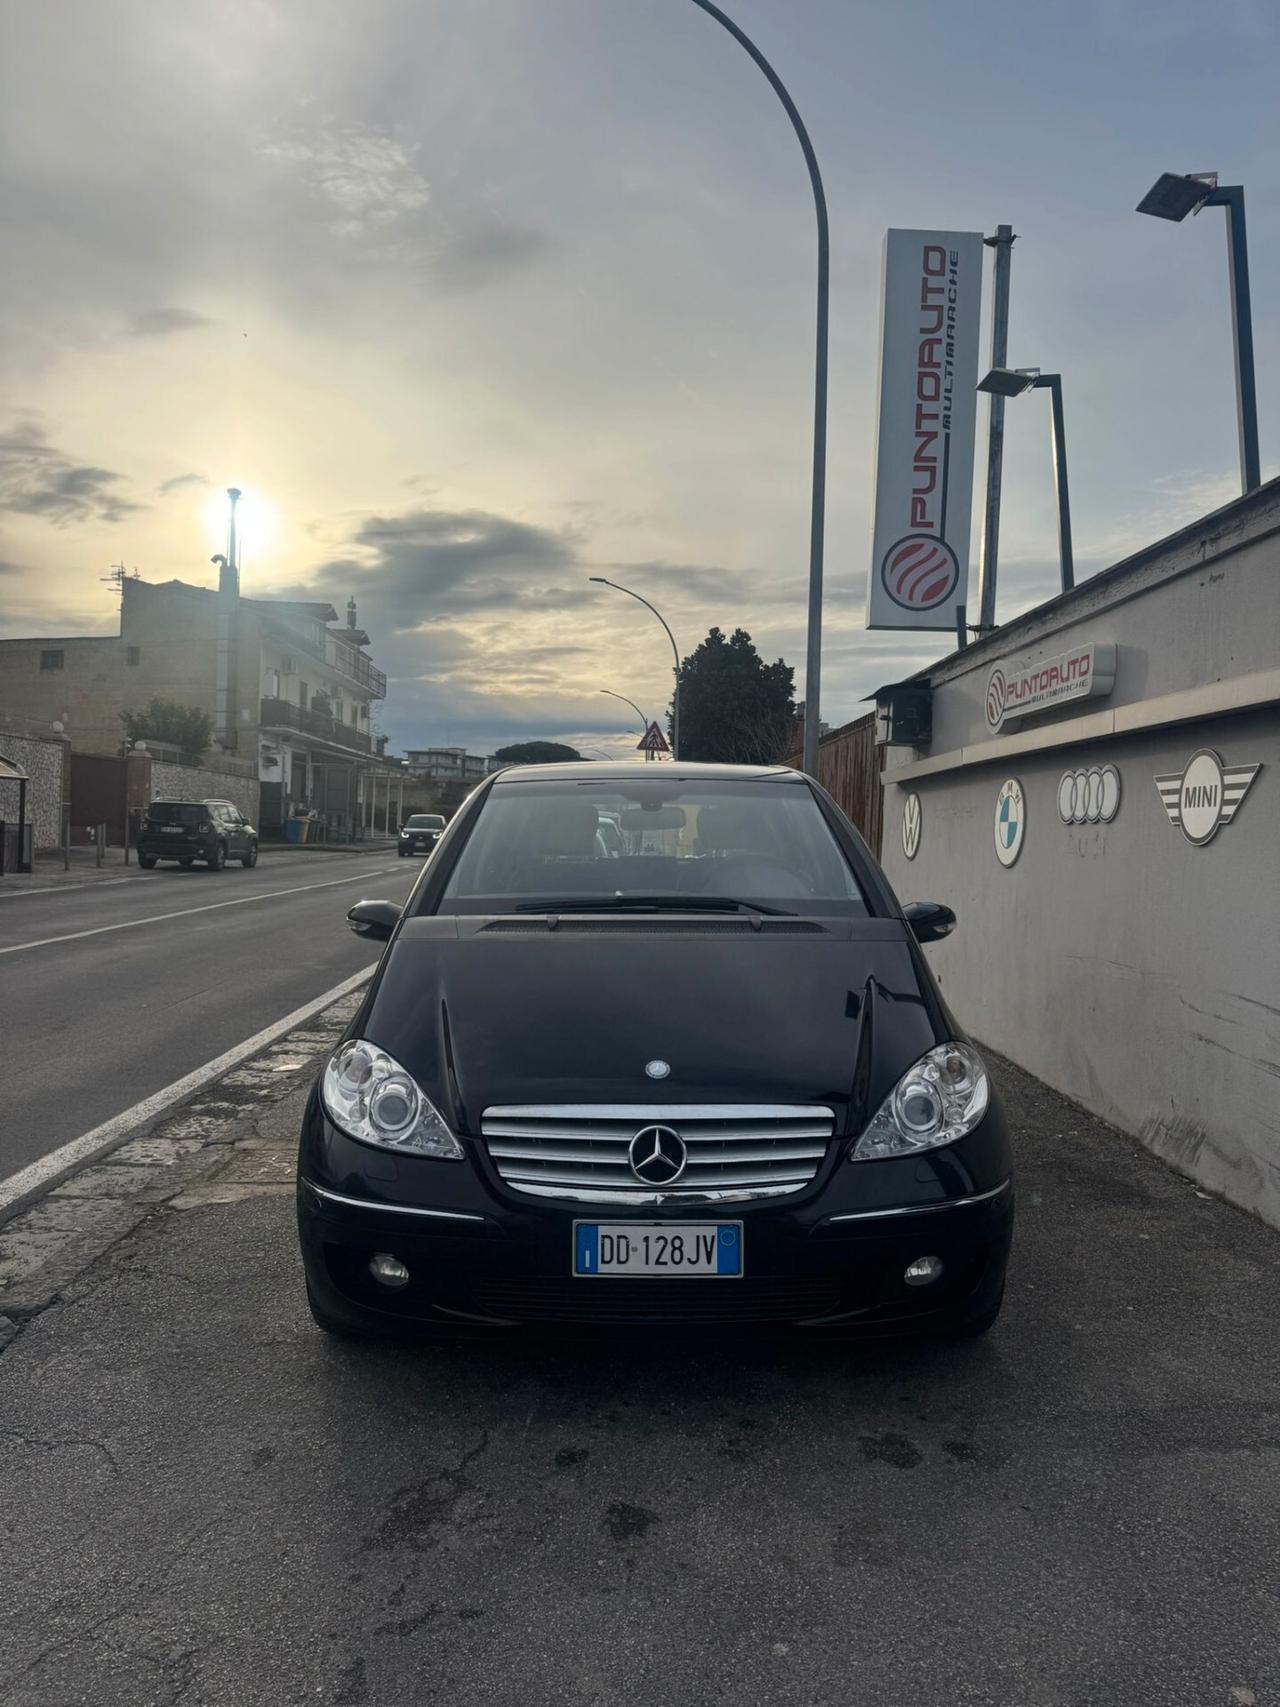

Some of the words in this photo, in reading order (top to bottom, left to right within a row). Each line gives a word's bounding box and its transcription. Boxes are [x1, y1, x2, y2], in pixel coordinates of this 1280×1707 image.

[911, 245, 946, 528] PUNTOAUTO
[942, 250, 959, 430] MULTIMARCHE
[1006, 654, 1090, 702] PUNTOAUTO
[1184, 785, 1218, 809] MINI
